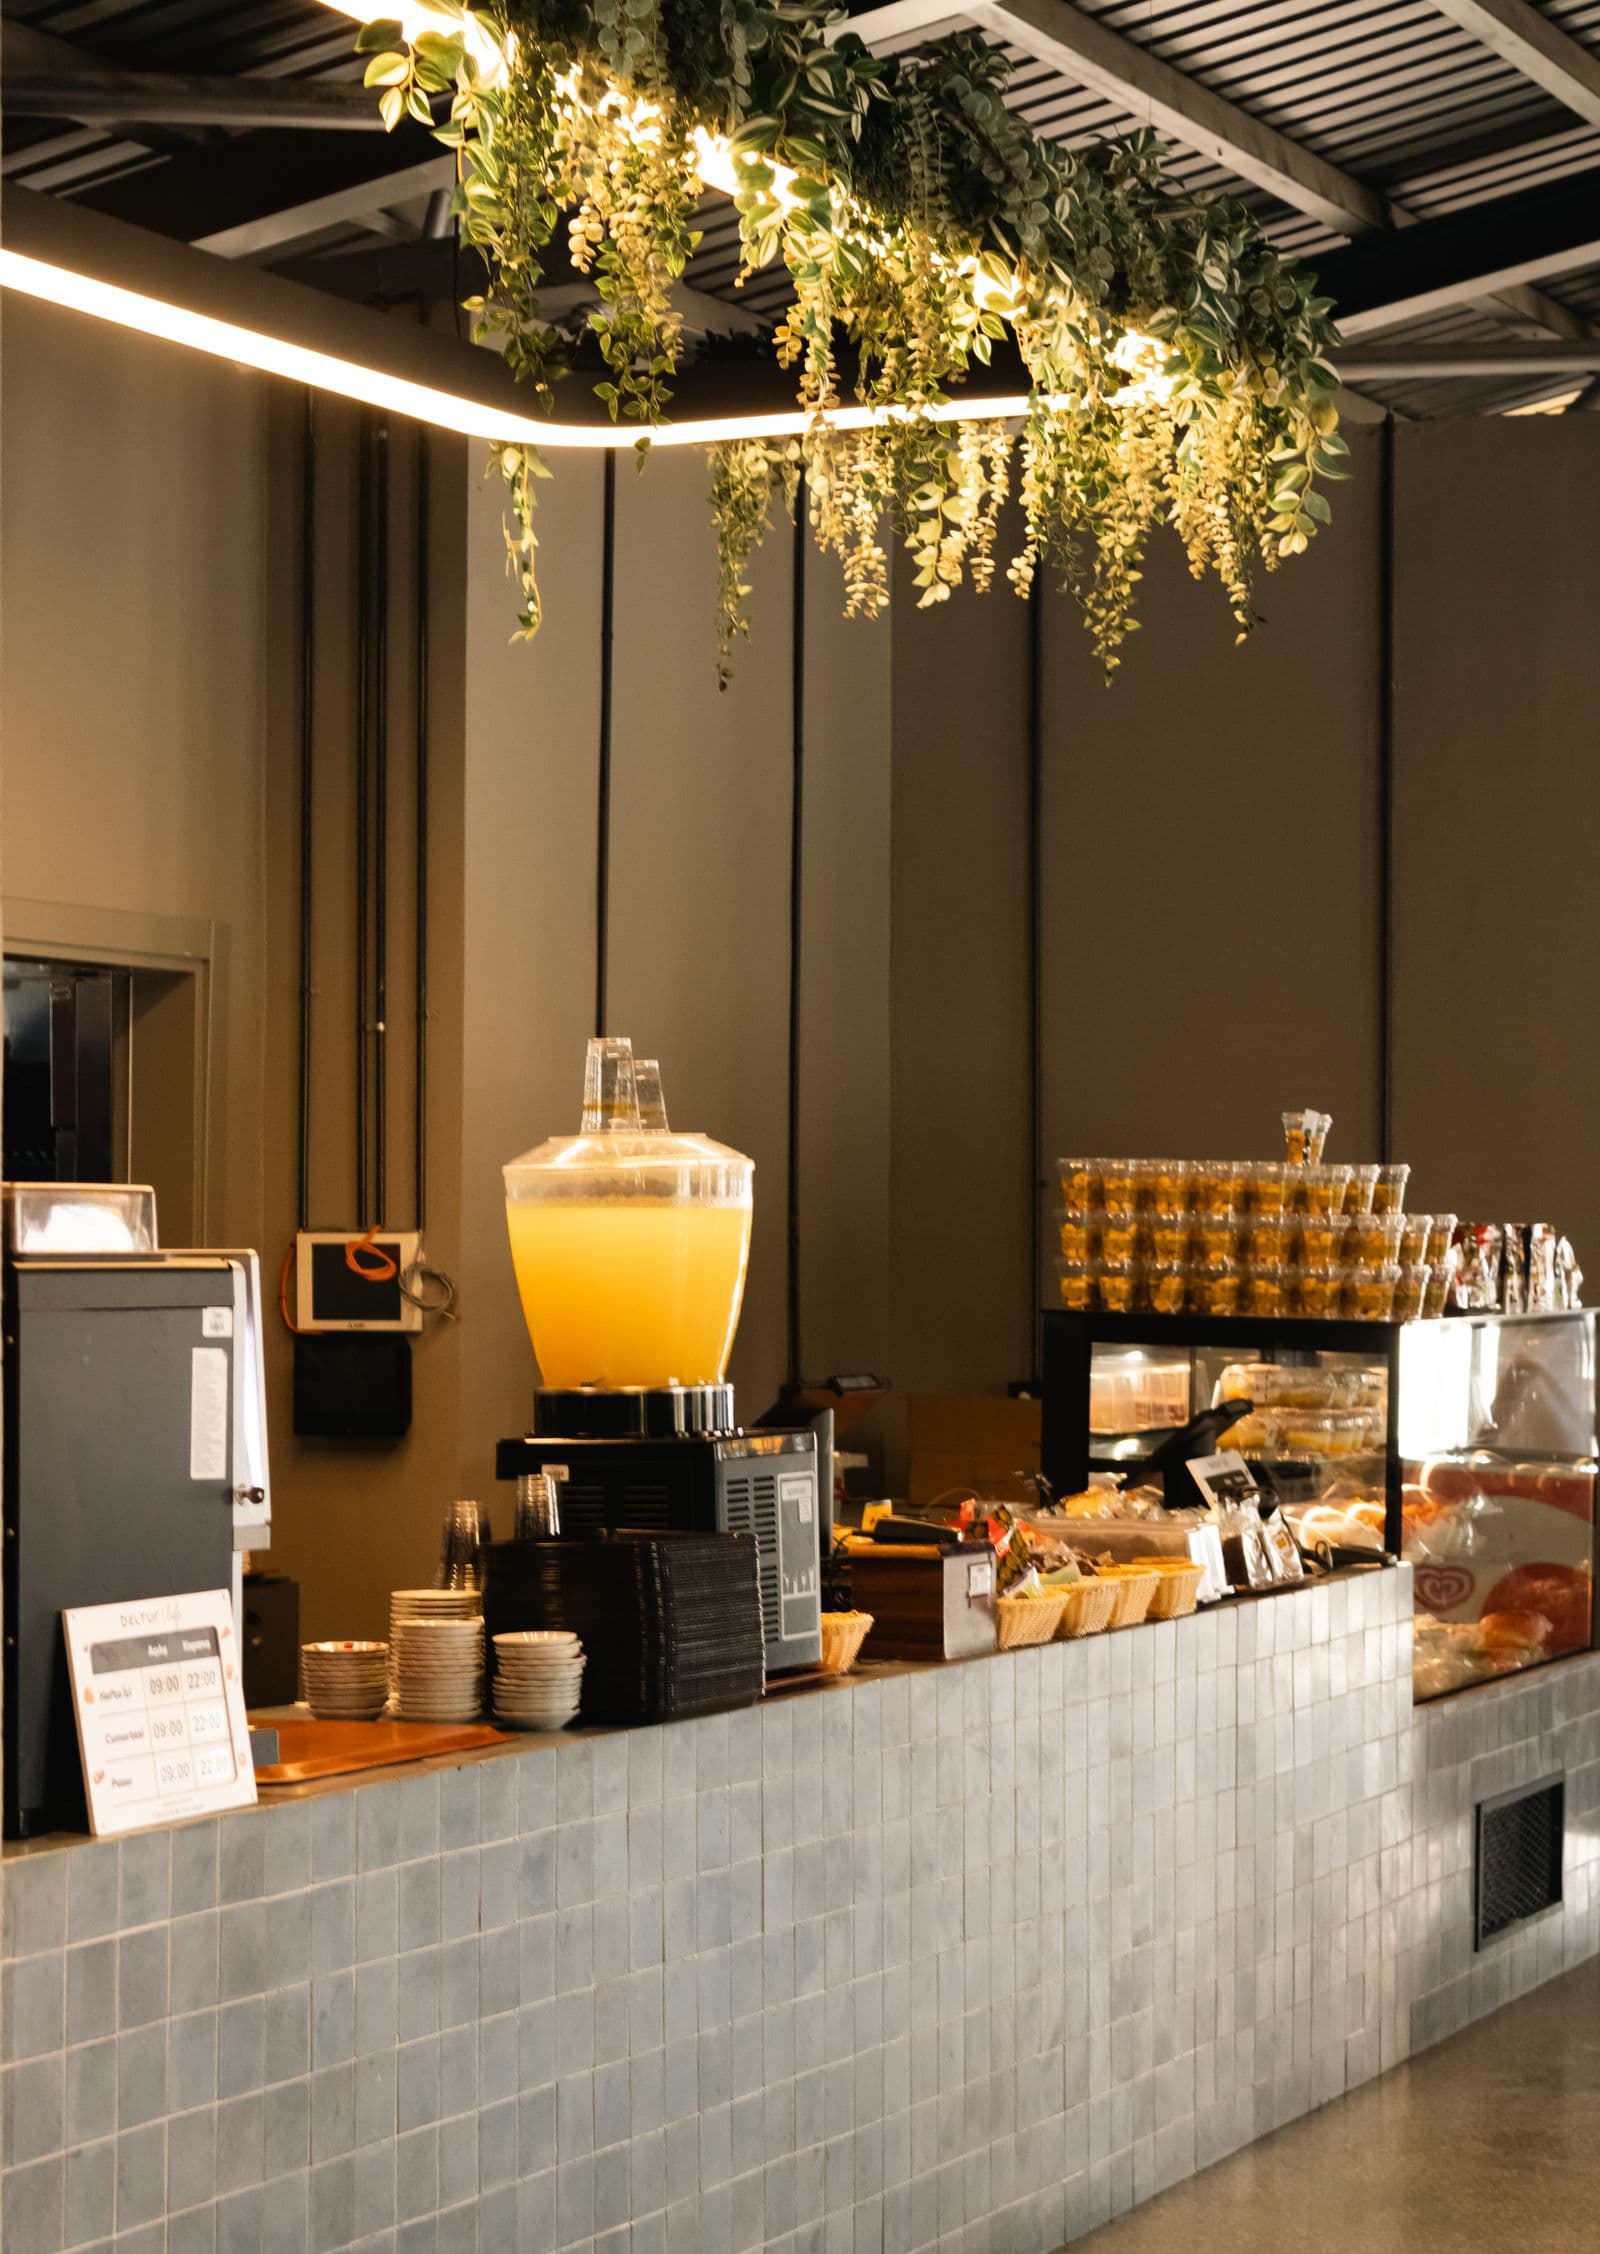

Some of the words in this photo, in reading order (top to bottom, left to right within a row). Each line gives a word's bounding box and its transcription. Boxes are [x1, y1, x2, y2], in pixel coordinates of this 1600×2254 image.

[149, 1674, 180, 1695] 09:00
[187, 1670, 216, 1689] 22:00
[153, 1719, 183, 1738] 09:00
[192, 1713, 220, 1733] 22:00
[160, 1761, 190, 1782] 09:00
